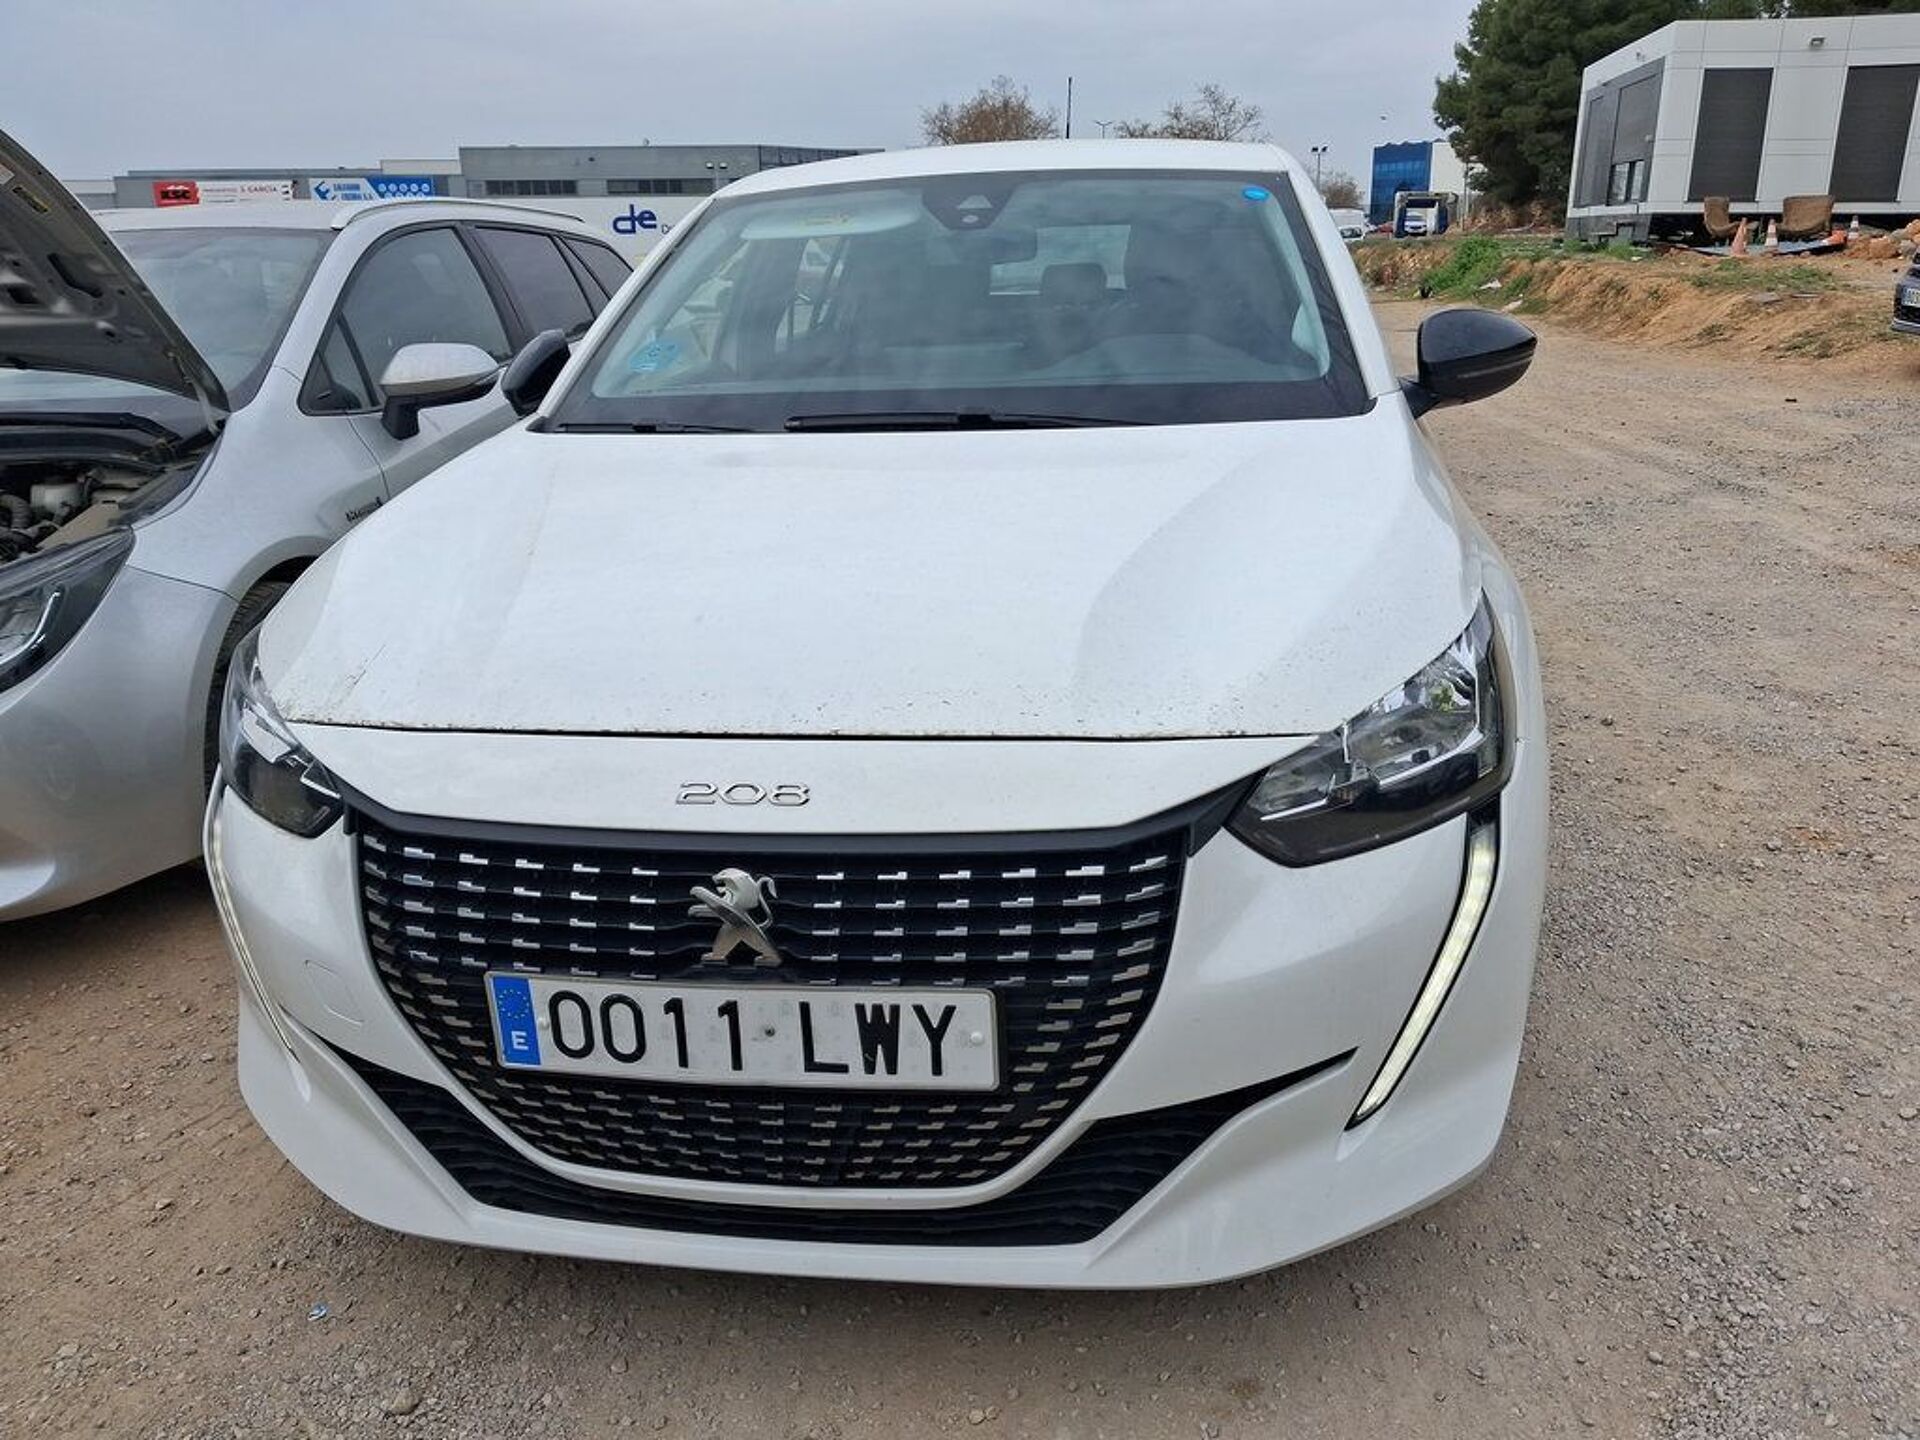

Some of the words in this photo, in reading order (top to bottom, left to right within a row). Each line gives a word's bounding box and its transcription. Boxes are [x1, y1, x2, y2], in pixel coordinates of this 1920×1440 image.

[676, 782, 811, 807] 208
[510, 1030, 529, 1051] E
[548, 990, 743, 1072] 0011
[798, 1000, 958, 1077] LWY
